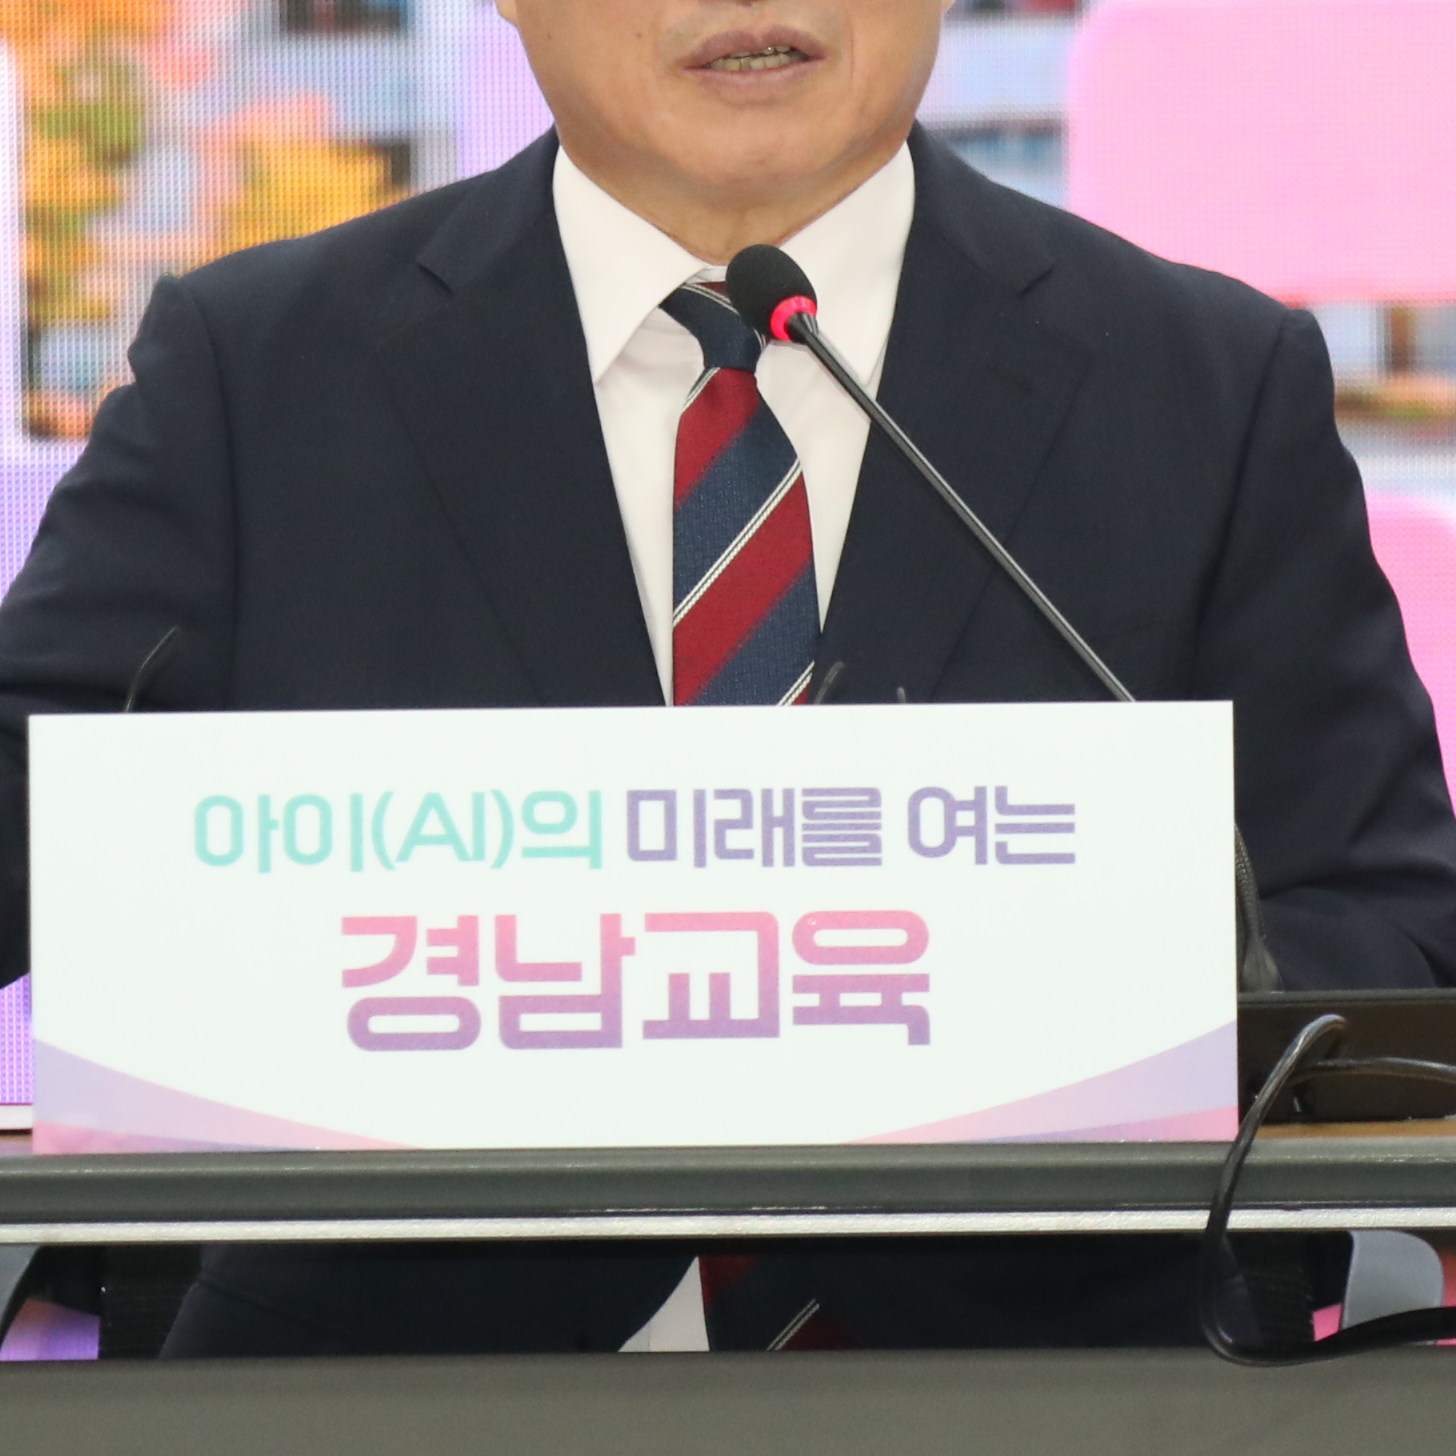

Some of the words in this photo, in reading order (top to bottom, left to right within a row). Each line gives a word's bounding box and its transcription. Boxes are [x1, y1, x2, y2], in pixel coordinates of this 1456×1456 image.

[193, 788, 604, 874] 아이(AI)의
[627, 787, 882, 868] 미래를
[908, 786, 1077, 866] 여는
[341, 909, 931, 1051] 경남교육
